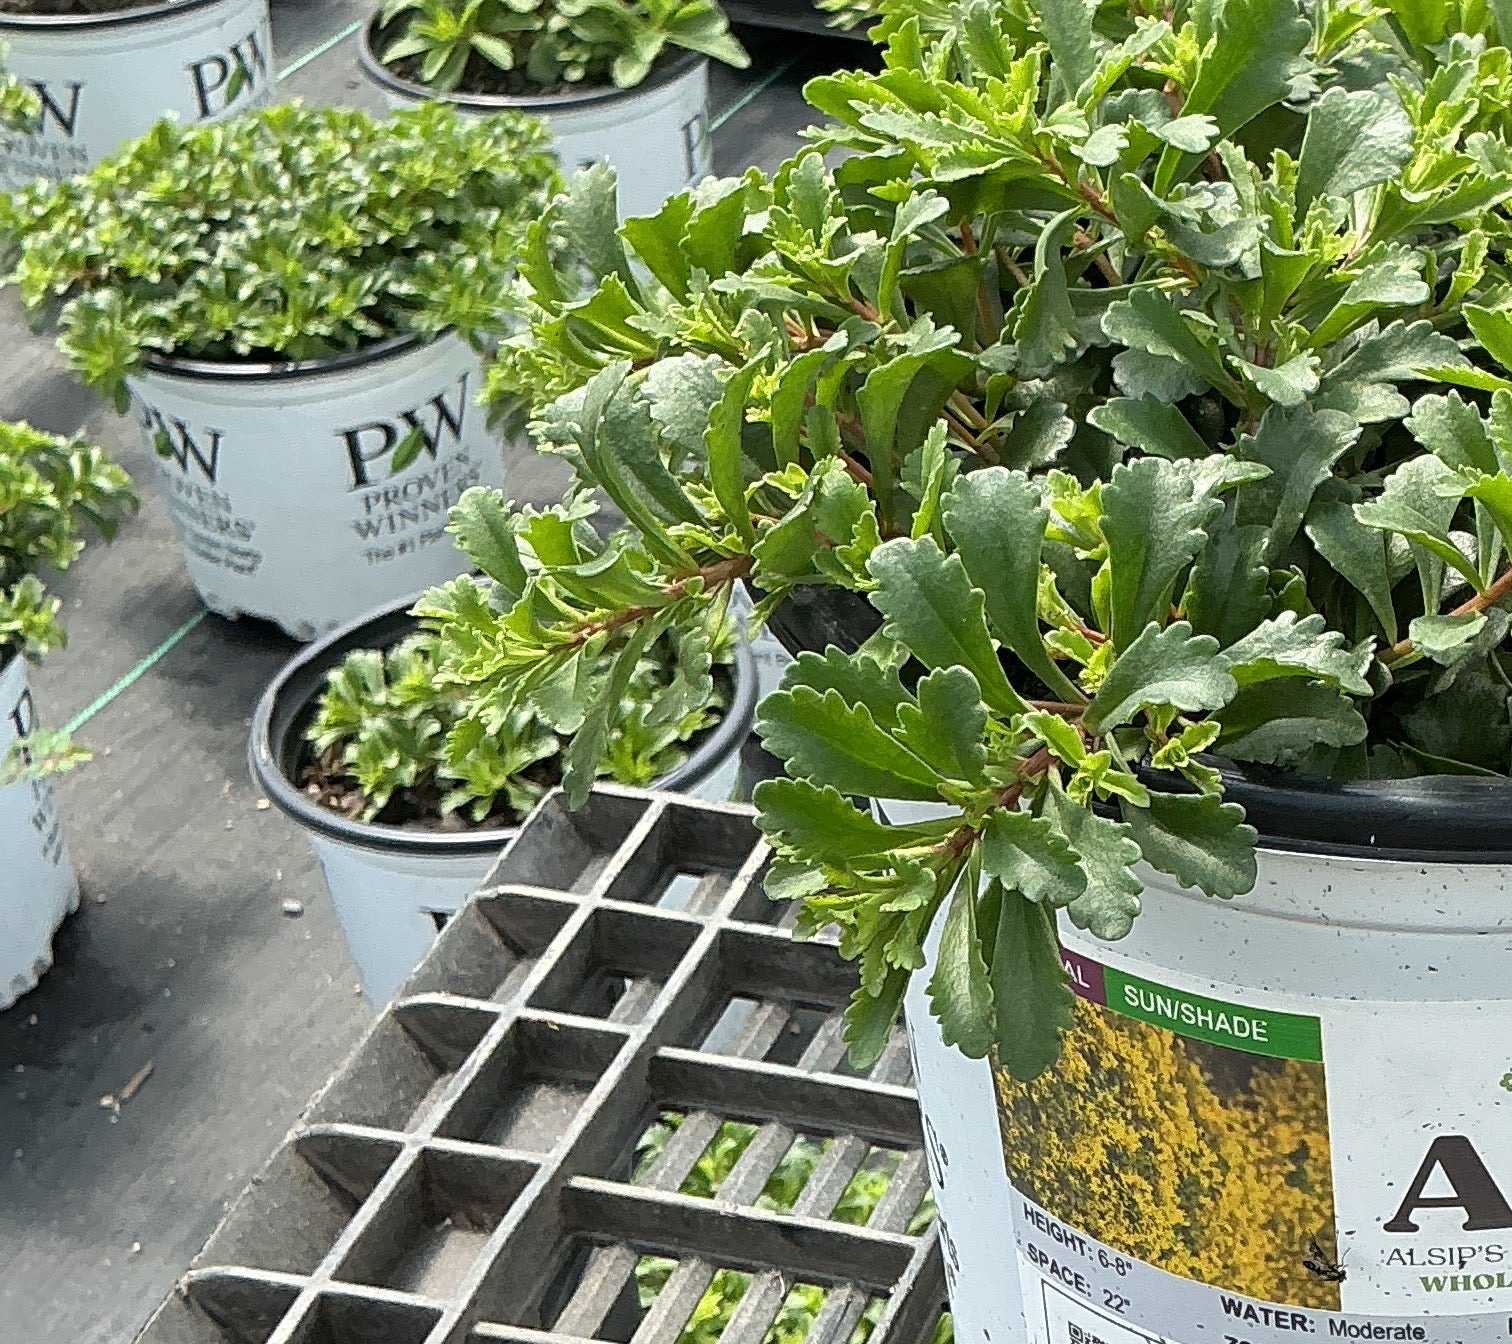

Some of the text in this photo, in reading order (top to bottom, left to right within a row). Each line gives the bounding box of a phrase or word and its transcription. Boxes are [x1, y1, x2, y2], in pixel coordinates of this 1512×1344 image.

[333, 372, 469, 493] PW
[1062, 959, 1269, 1043] AL SUN/SHADE
[1023, 1202, 1132, 1277] HEIGHT: 6-8"
[1027, 1242, 1130, 1314] SPACE: 22"
[1220, 1295, 1425, 1341] WATER: Moderate
